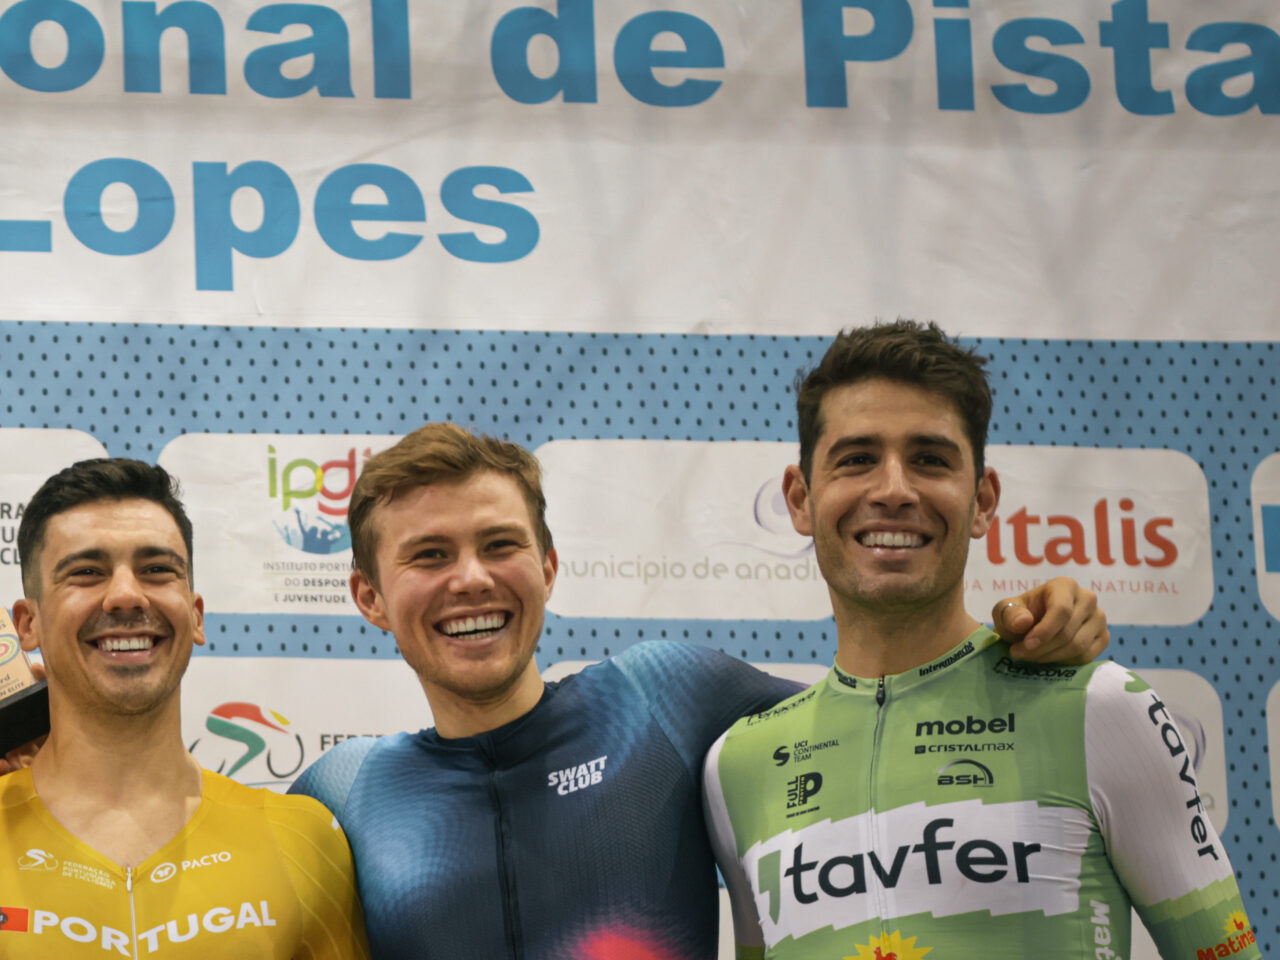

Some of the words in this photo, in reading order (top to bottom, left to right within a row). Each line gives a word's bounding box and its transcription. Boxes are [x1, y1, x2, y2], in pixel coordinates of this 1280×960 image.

[490, 0, 725, 107] de
[800, 0, 1280, 116] Pista
[986, 498, 1179, 568] italis
[263, 561, 317, 572] INSTITUTO
[320, 562, 353, 572] PORTU
[692, 555, 729, 581] de
[735, 557, 818, 581] anadi
[303, 578, 349, 588] DESPOR
[1090, 580, 1180, 595] NATURAL
[282, 593, 347, 603] JUVENTUDE
[915, 712, 1016, 737] mobel
[793, 739, 840, 757] CONTINENTAL
[794, 740, 808, 749] UCI
[794, 753, 812, 763] TEAM
[548, 755, 608, 787] SWATT
[557, 770, 603, 796] CLUB
[1147, 693, 1220, 861] tavfer
[786, 776, 799, 809] FULL
[181, 851, 232, 871] PACTO
[783, 818, 1042, 905] tavfer
[33, 900, 277, 958] PORTUGAL
